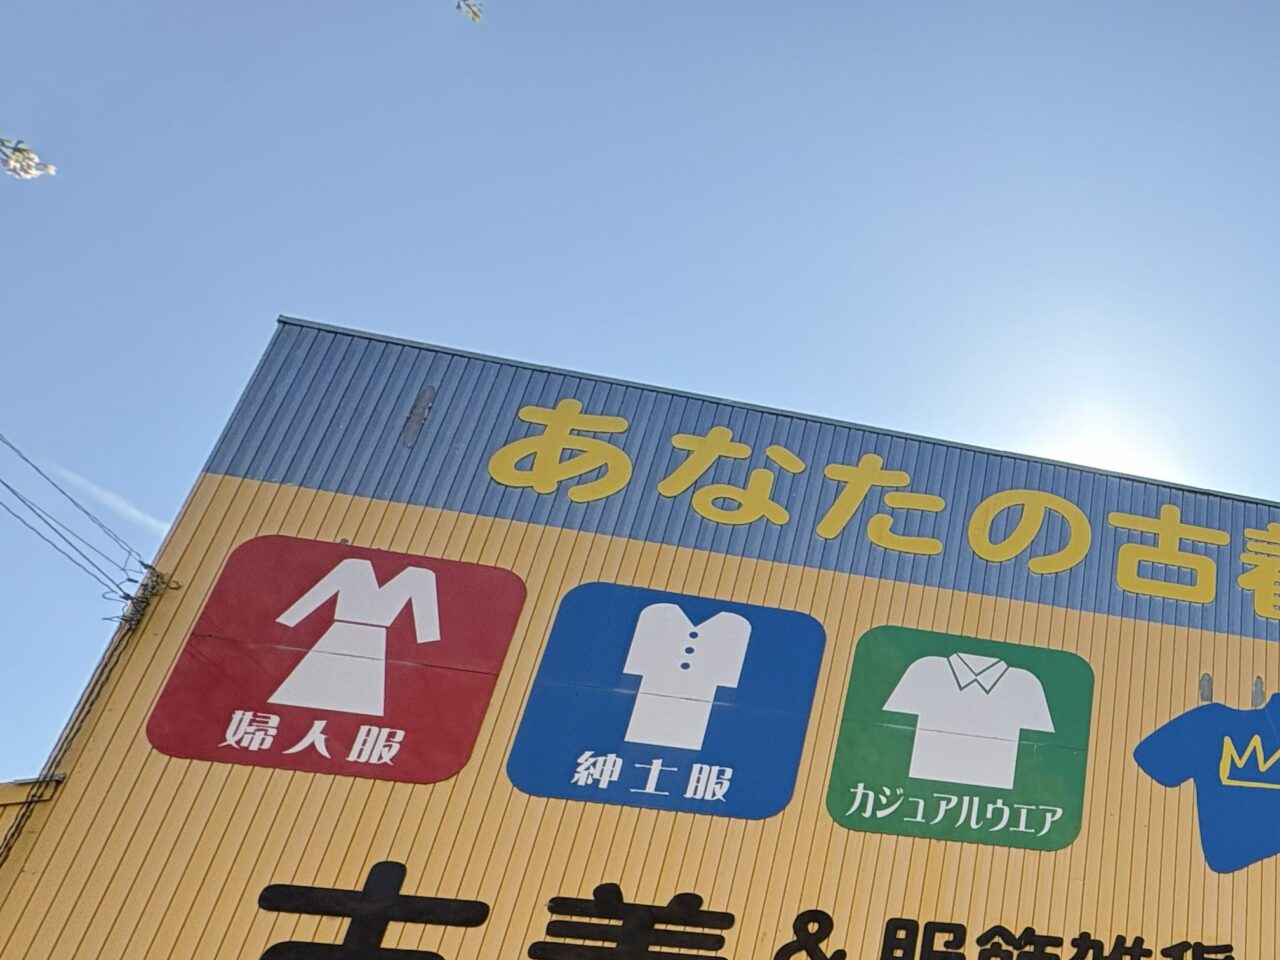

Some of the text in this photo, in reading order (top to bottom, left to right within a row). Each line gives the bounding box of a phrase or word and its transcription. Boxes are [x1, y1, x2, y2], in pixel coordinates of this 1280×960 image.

[217, 710, 406, 767] 婦人服
[571, 750, 734, 802] 紳士服
[848, 782, 1064, 838] カジュアルウエア
